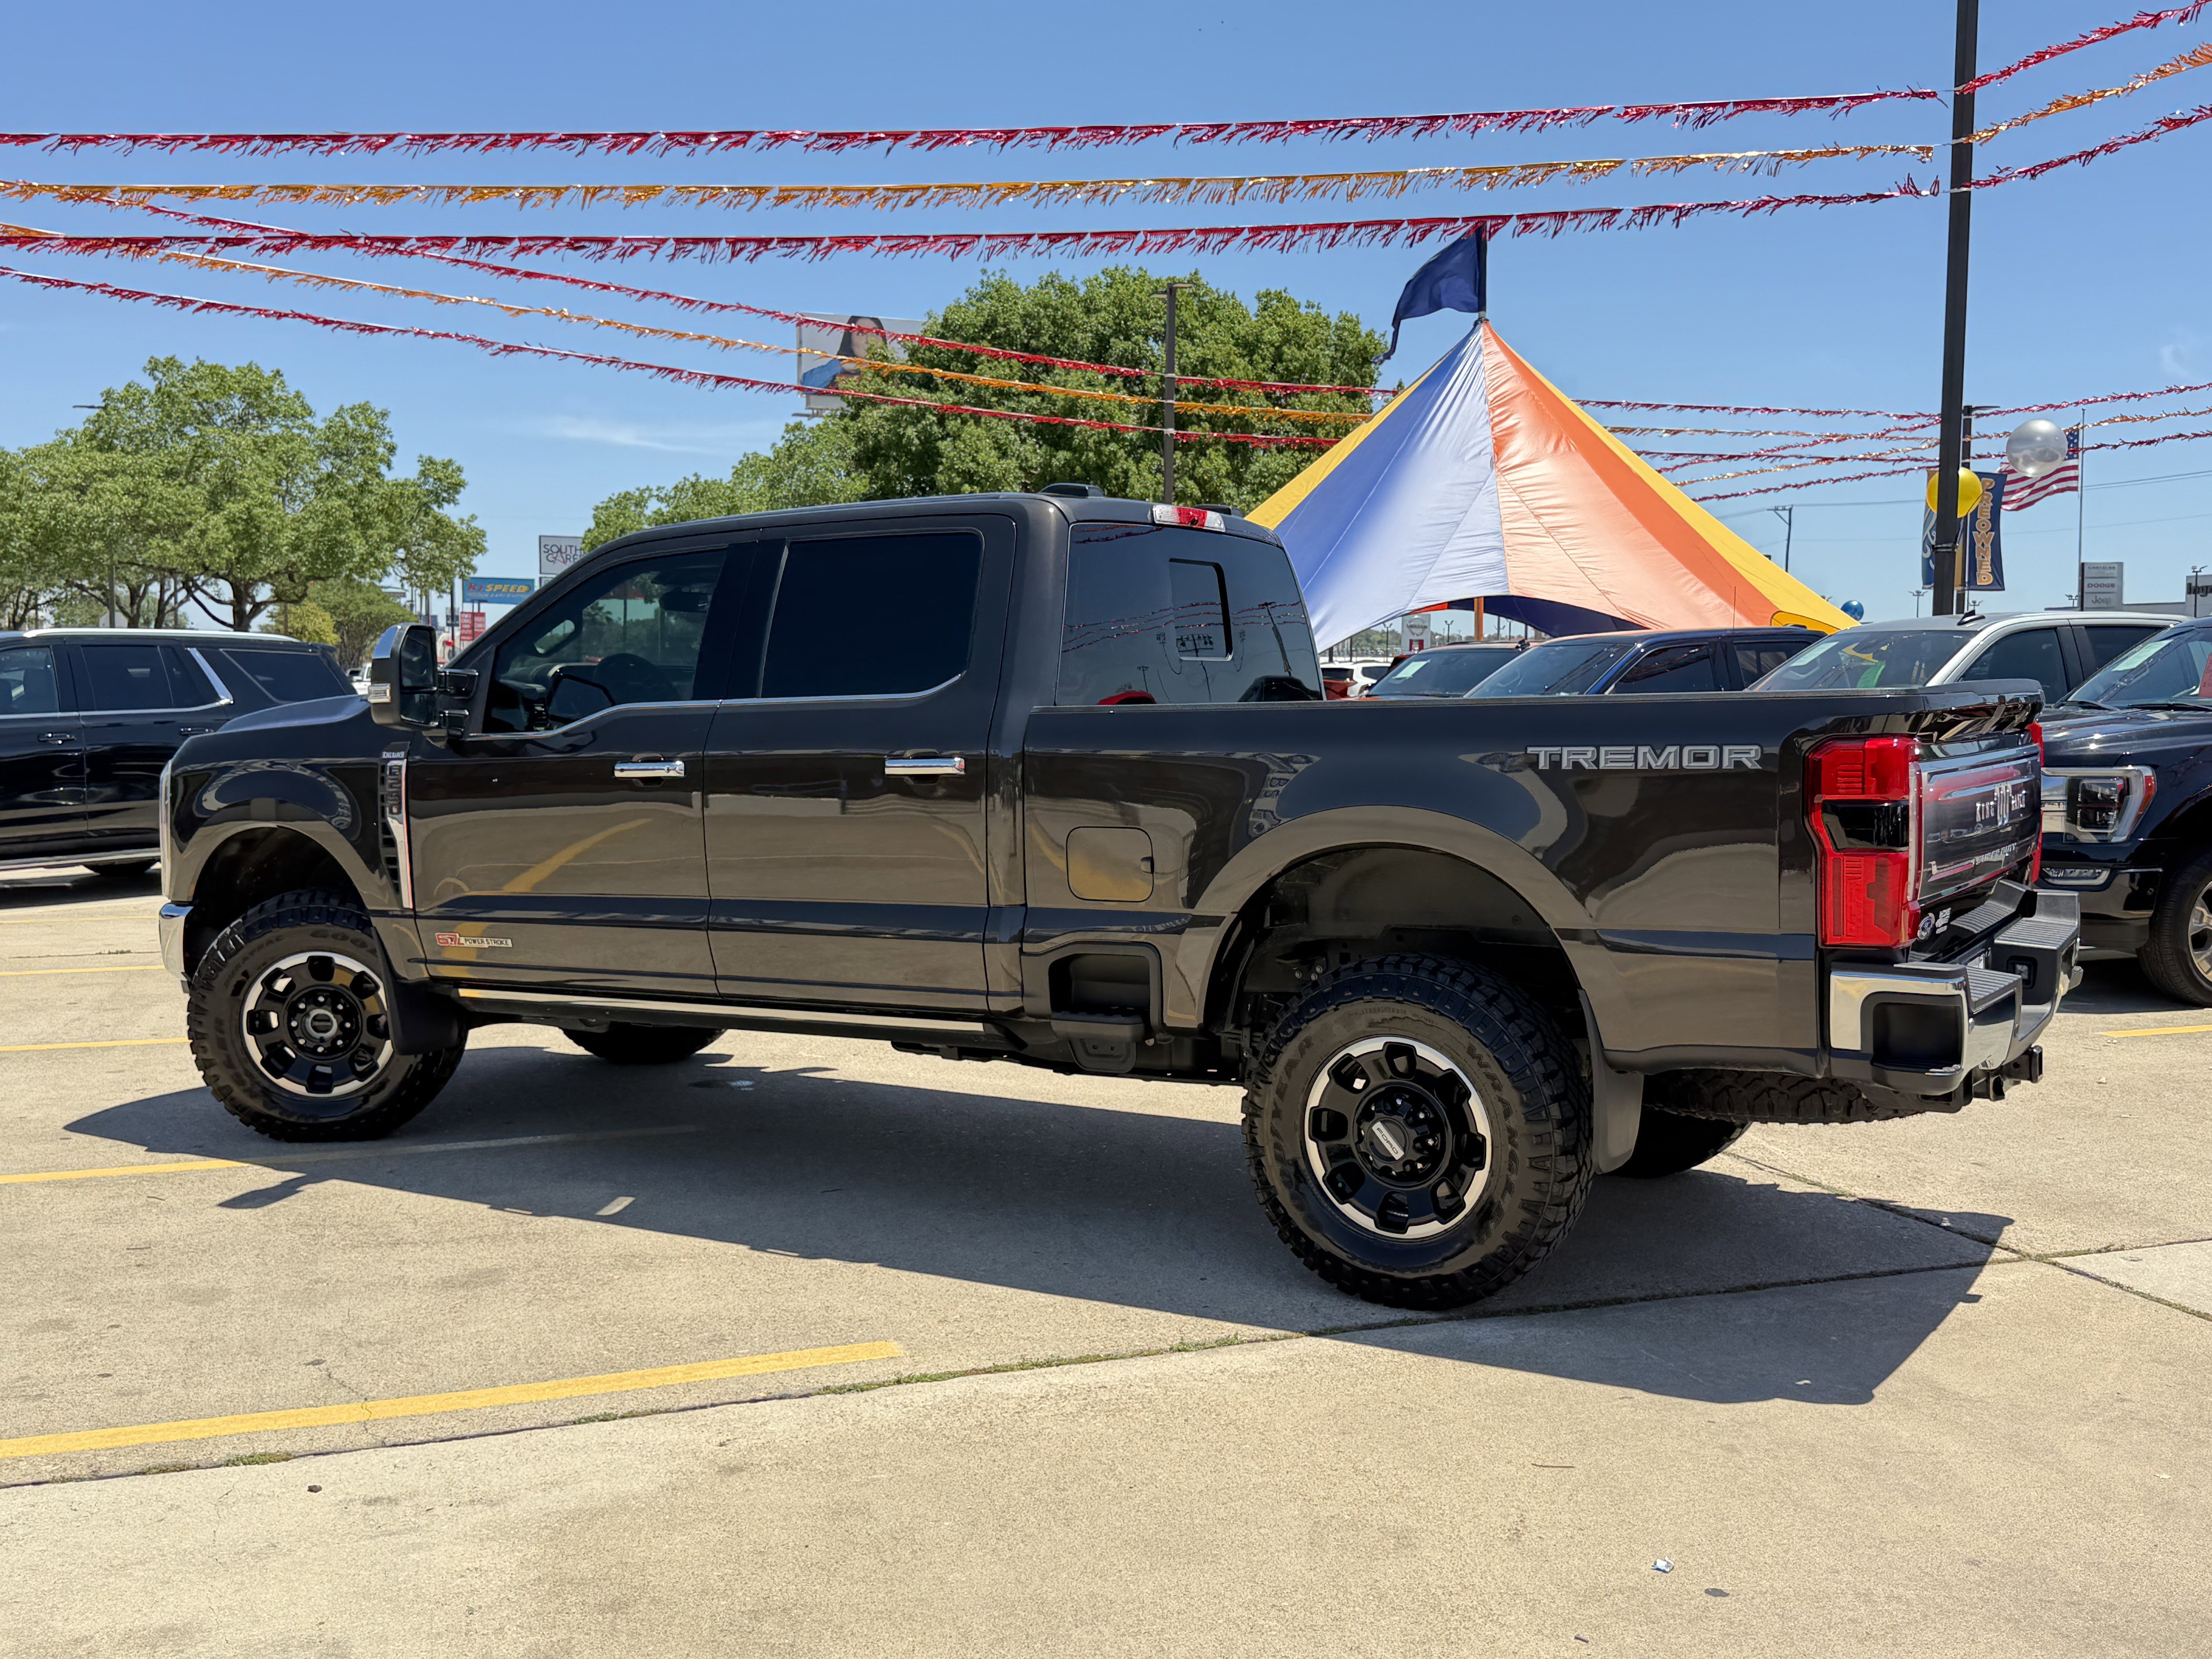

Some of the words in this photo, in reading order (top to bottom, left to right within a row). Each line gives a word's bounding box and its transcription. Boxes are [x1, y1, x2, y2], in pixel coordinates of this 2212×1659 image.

[1973, 478, 1995, 585] PREOWNED
[546, 548, 583, 565] CARE
[486, 584, 531, 593] SPEED
[1527, 745, 1762, 770] TREMOR
[1377, 1127, 1398, 1154] FORD
